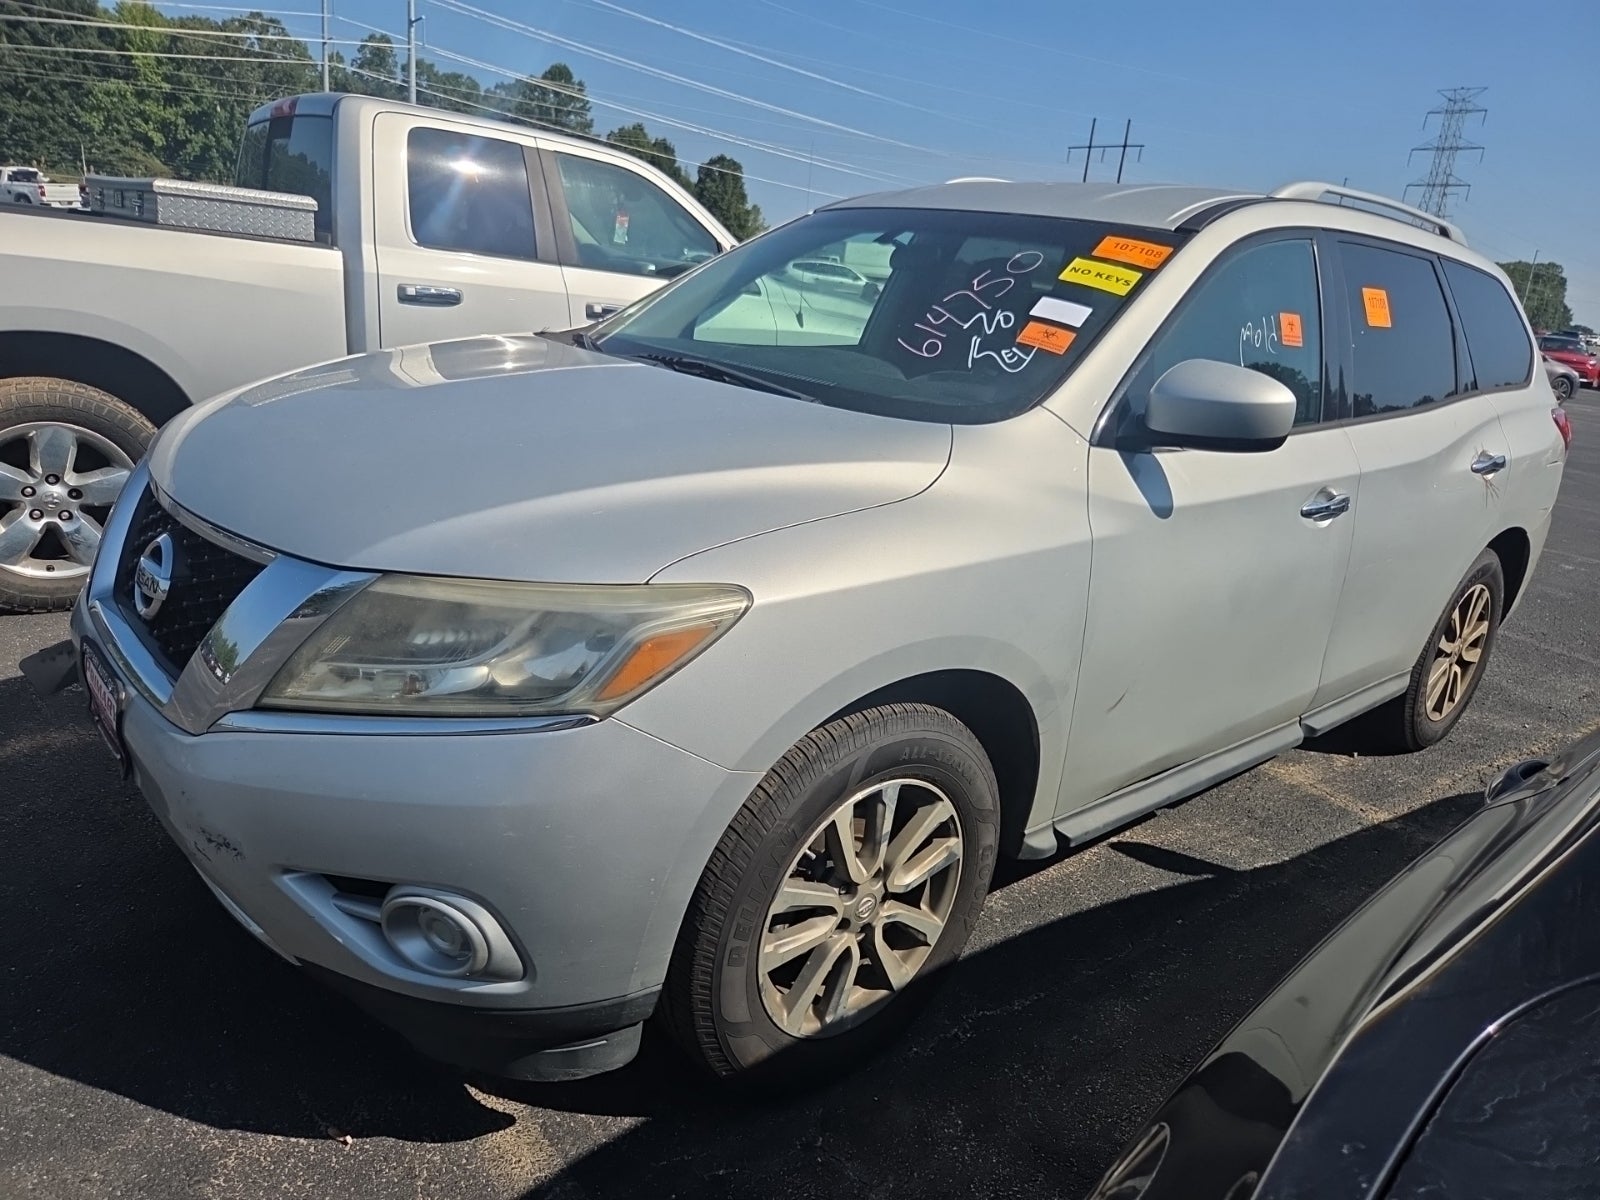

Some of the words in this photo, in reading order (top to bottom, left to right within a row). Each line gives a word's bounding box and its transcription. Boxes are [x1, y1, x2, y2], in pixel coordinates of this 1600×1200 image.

[1113, 241, 1164, 259] 107108
[1069, 265, 1092, 277] NO
[1094, 270, 1132, 287] KEYS
